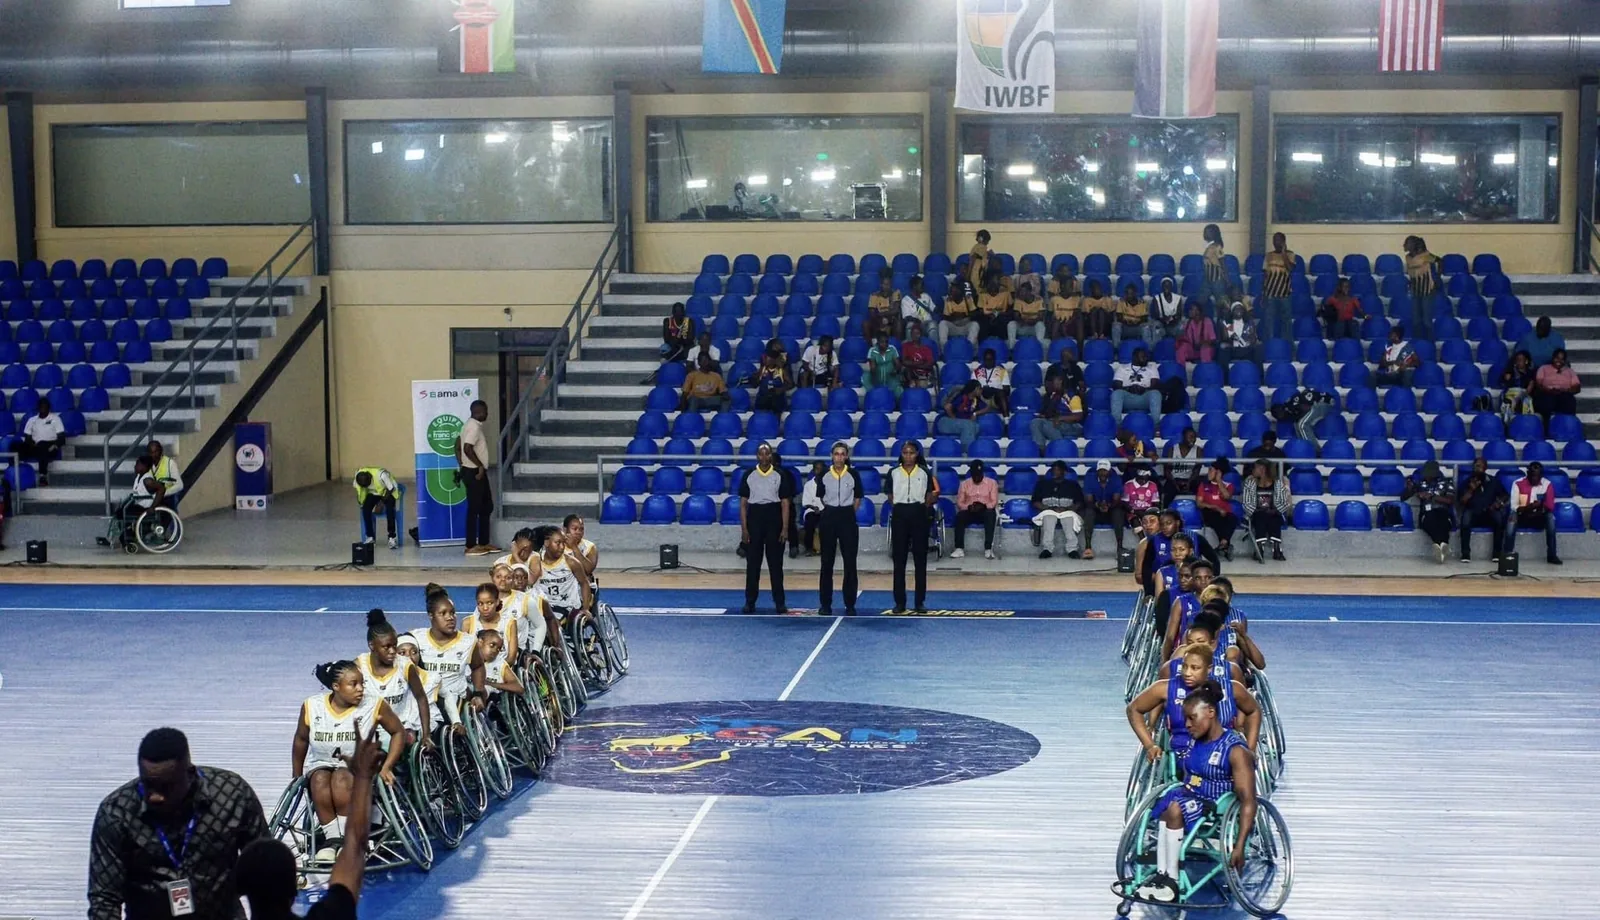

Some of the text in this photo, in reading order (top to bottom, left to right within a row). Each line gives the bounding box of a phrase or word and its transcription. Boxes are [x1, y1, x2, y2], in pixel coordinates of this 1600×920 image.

[985, 85, 1050, 108] IWBF
[432, 415, 462, 427] EQUIPE
[548, 585, 560, 596] 13
[440, 663, 461, 673] AFRICA
[314, 731, 357, 742] SOUTH AFRIC
[332, 747, 342, 761] 4
